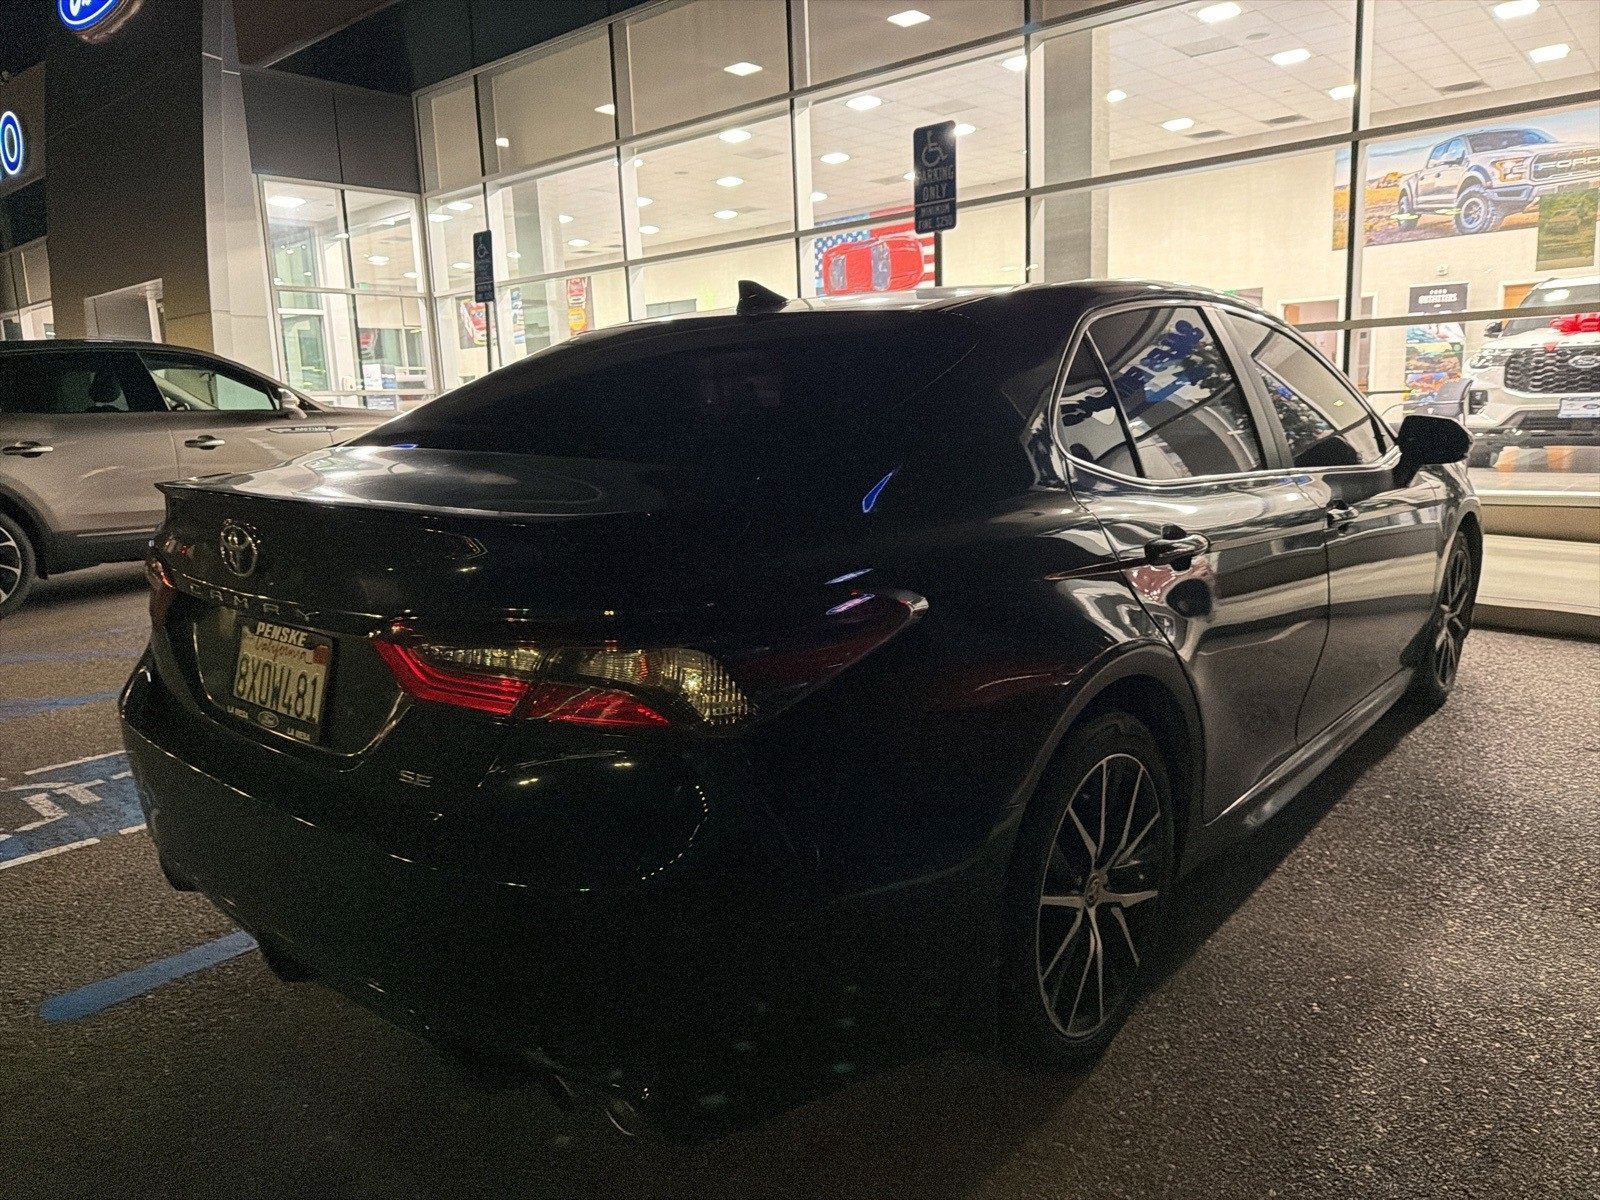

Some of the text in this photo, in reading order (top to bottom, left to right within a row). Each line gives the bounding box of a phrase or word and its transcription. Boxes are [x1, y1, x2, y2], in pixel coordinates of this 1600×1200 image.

[922, 184, 948, 201] ONLY
[189, 584, 320, 621] CAMRY
[256, 621, 308, 647] PENSKE
[399, 770, 433, 787] SE
